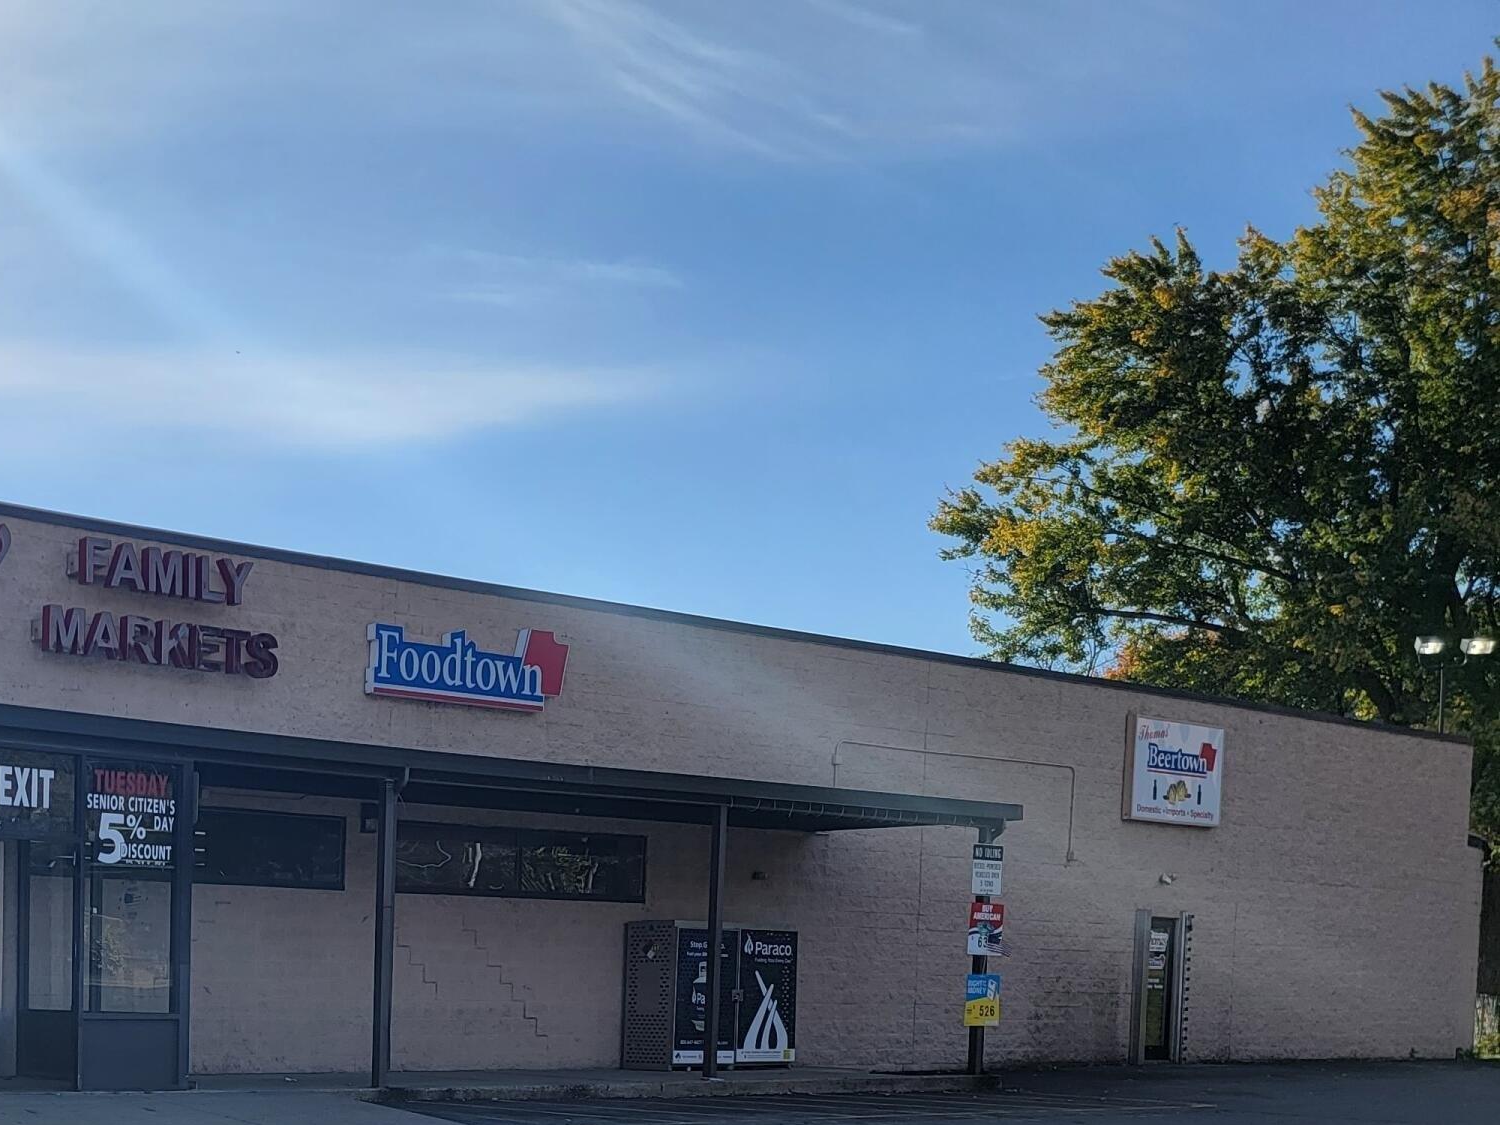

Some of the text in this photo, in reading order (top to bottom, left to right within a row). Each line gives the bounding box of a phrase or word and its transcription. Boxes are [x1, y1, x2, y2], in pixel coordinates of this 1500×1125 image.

[78, 536, 254, 606] FAMILY
[42, 604, 279, 679] MARKETS
[377, 629, 544, 697] Foodtown
[1149, 745, 1207, 773] Beertown
[94, 768, 169, 797] TUESDAY
[86, 793, 176, 815] SENIOR CITIZEN'S
[153, 815, 175, 832] DAY
[120, 843, 172, 861] DISCOUNT
[755, 941, 793, 956] Paraco
[978, 1005, 996, 1017] 526
